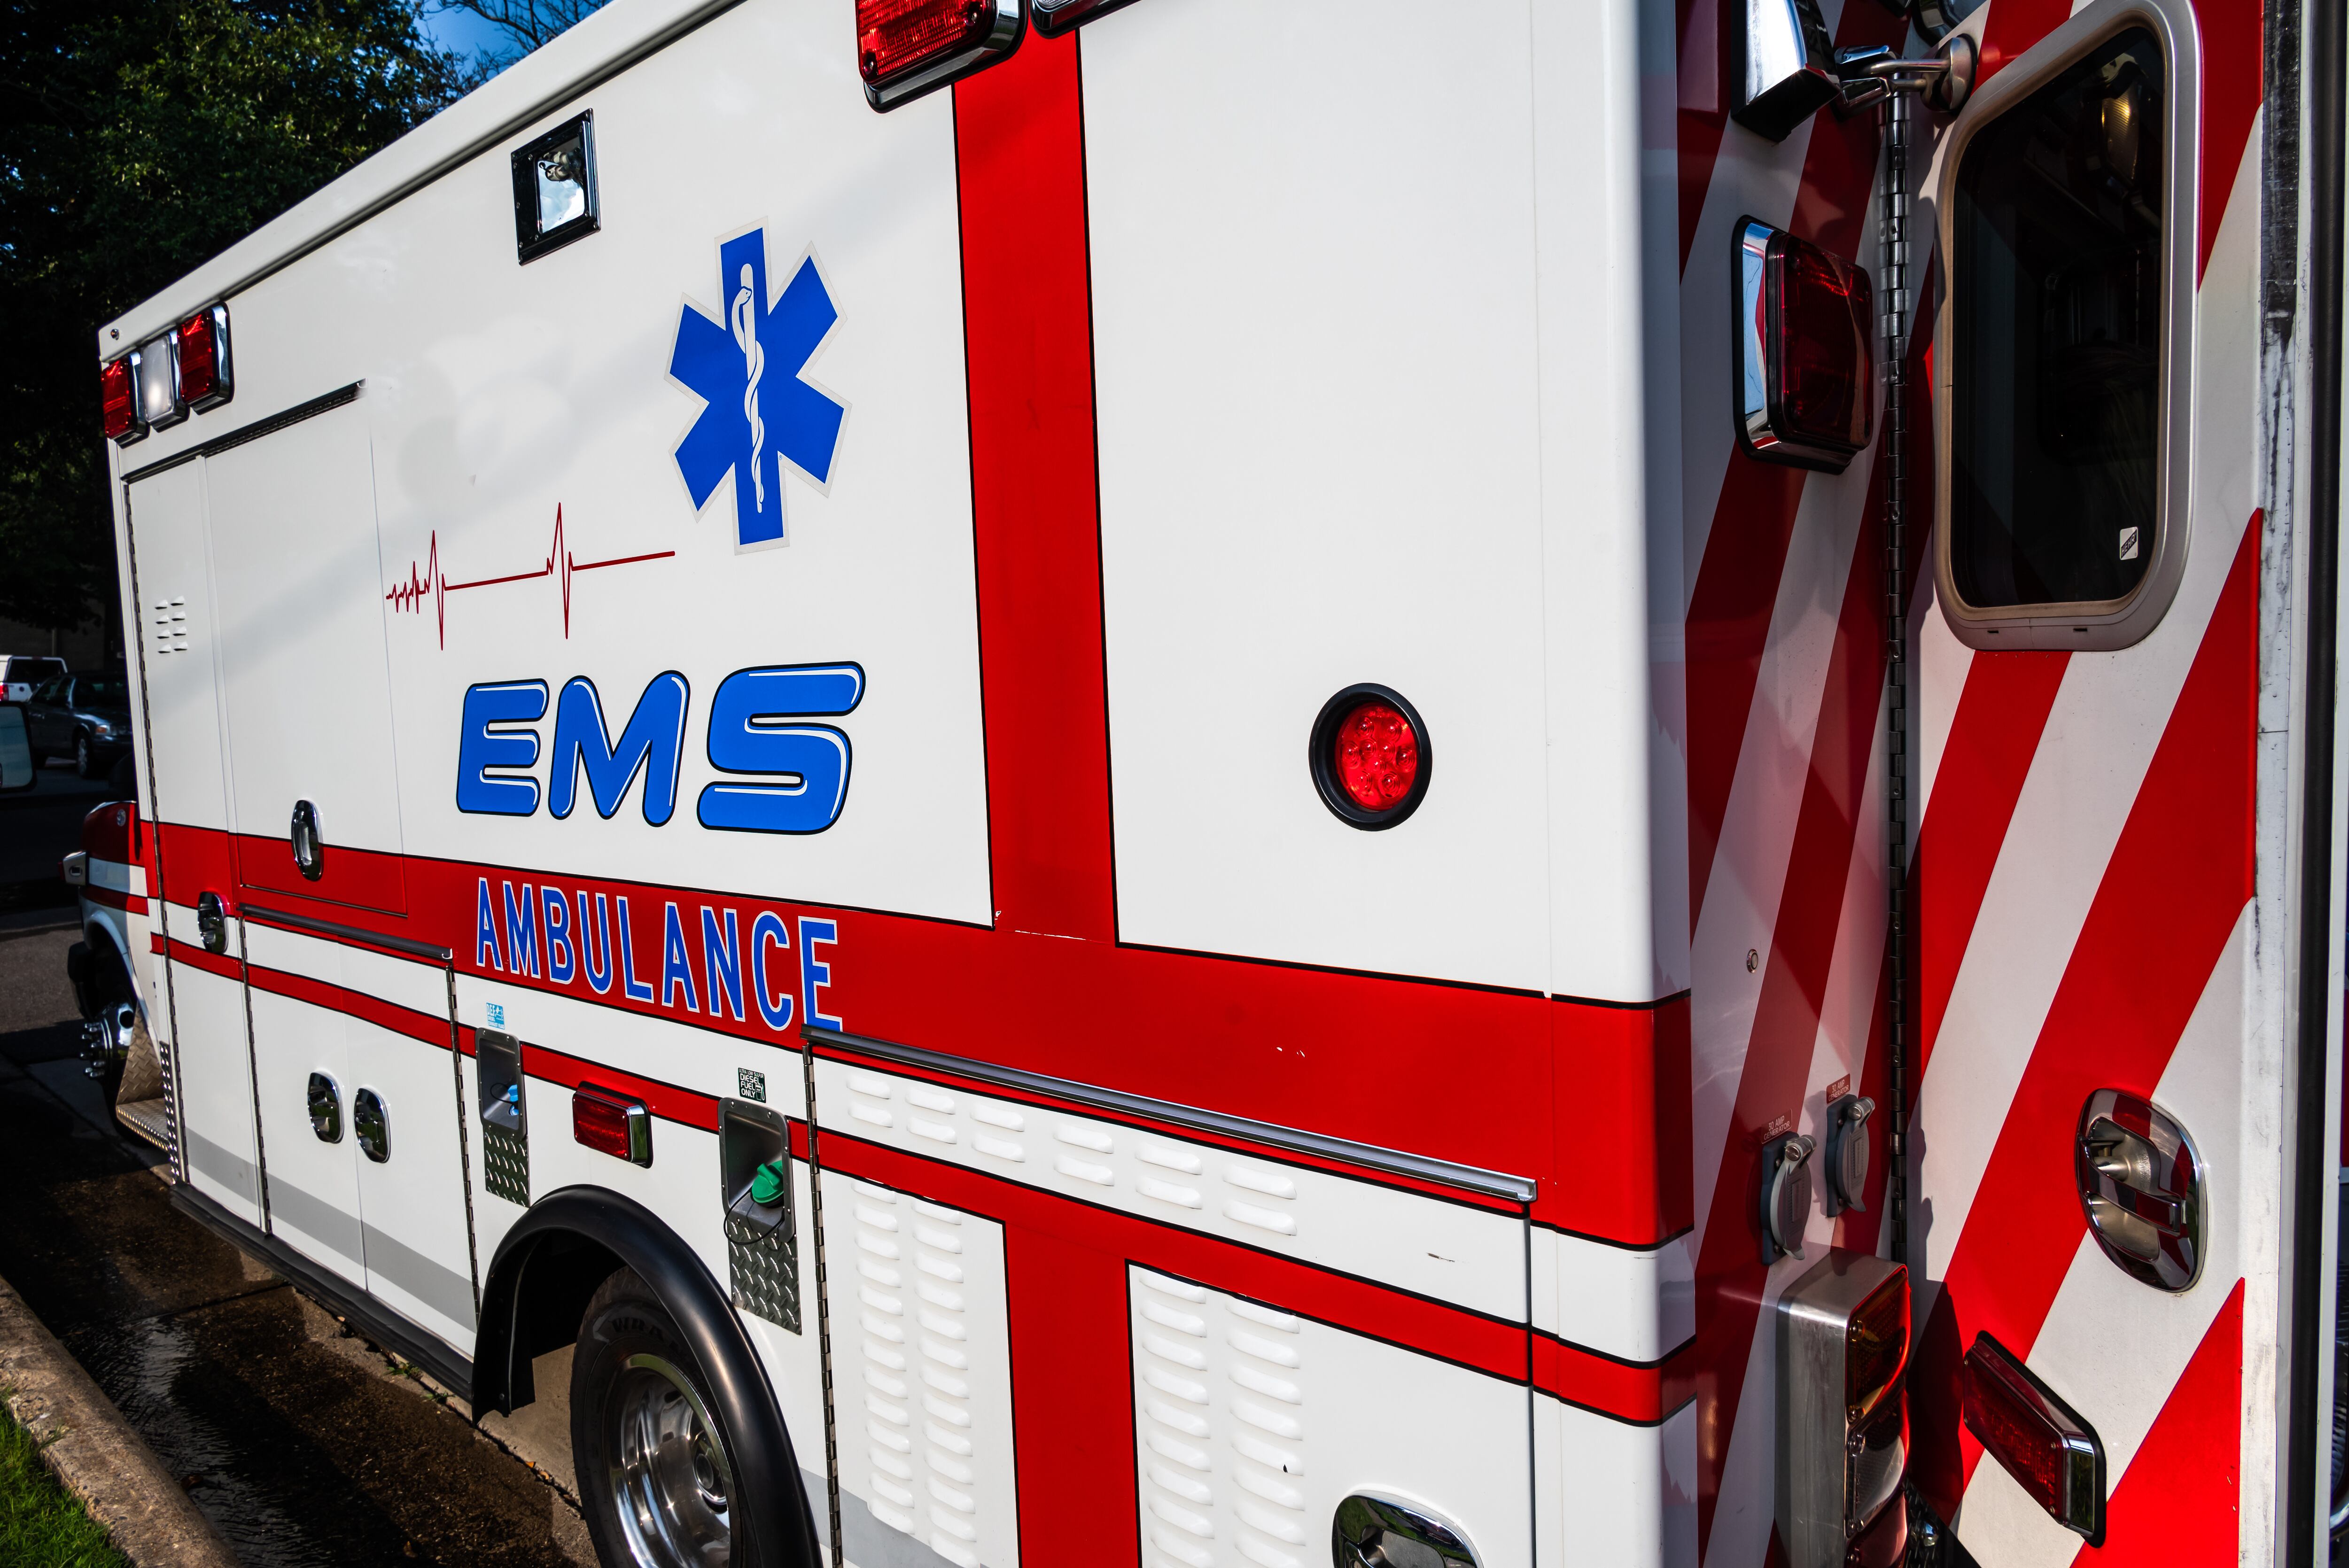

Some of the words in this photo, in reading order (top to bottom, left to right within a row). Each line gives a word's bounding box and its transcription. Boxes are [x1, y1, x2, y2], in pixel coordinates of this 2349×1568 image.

[2122, 534, 2135, 557] HEHR
[456, 660, 866, 835] EMS
[476, 877, 843, 1032] AMBULANCE
[487, 1003, 495, 1017] DEF
[740, 1073, 761, 1085] DIESEL
[741, 1081, 755, 1091] FUEL
[741, 1088, 755, 1098] ONLY
[1828, 1085, 1849, 1102] GENERATOR
[1832, 1084, 1836, 1093] 30
[1764, 1121, 1790, 1140] GENERATOR
[1769, 1121, 1774, 1131] 30
[1775, 1115, 1785, 1128] AMP
